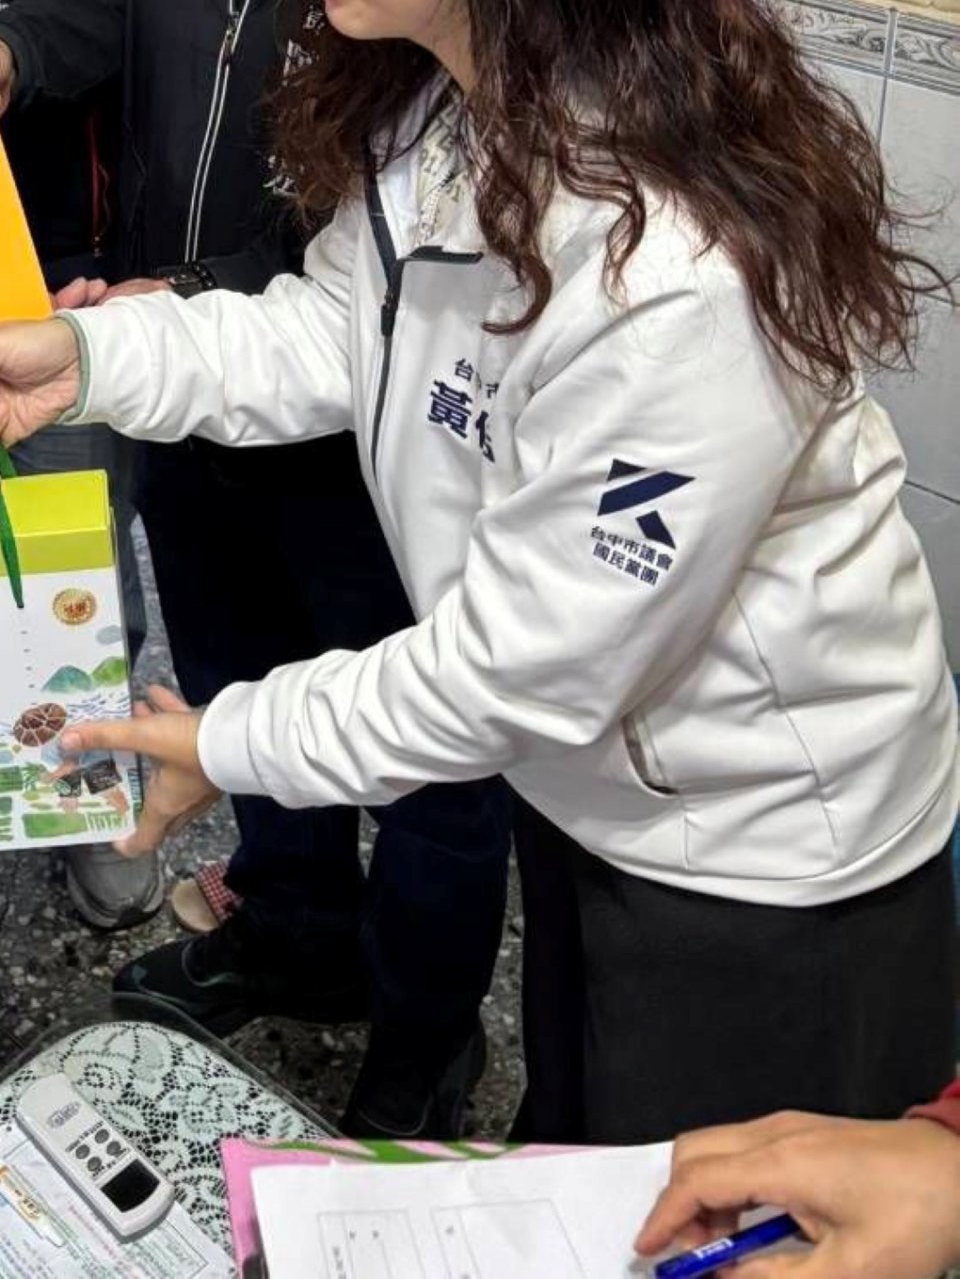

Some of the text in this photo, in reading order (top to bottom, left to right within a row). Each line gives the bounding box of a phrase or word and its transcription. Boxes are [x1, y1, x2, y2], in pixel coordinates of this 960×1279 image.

[591, 526, 673, 571] 台中市議會
[593, 541, 659, 587] 國民黨團
